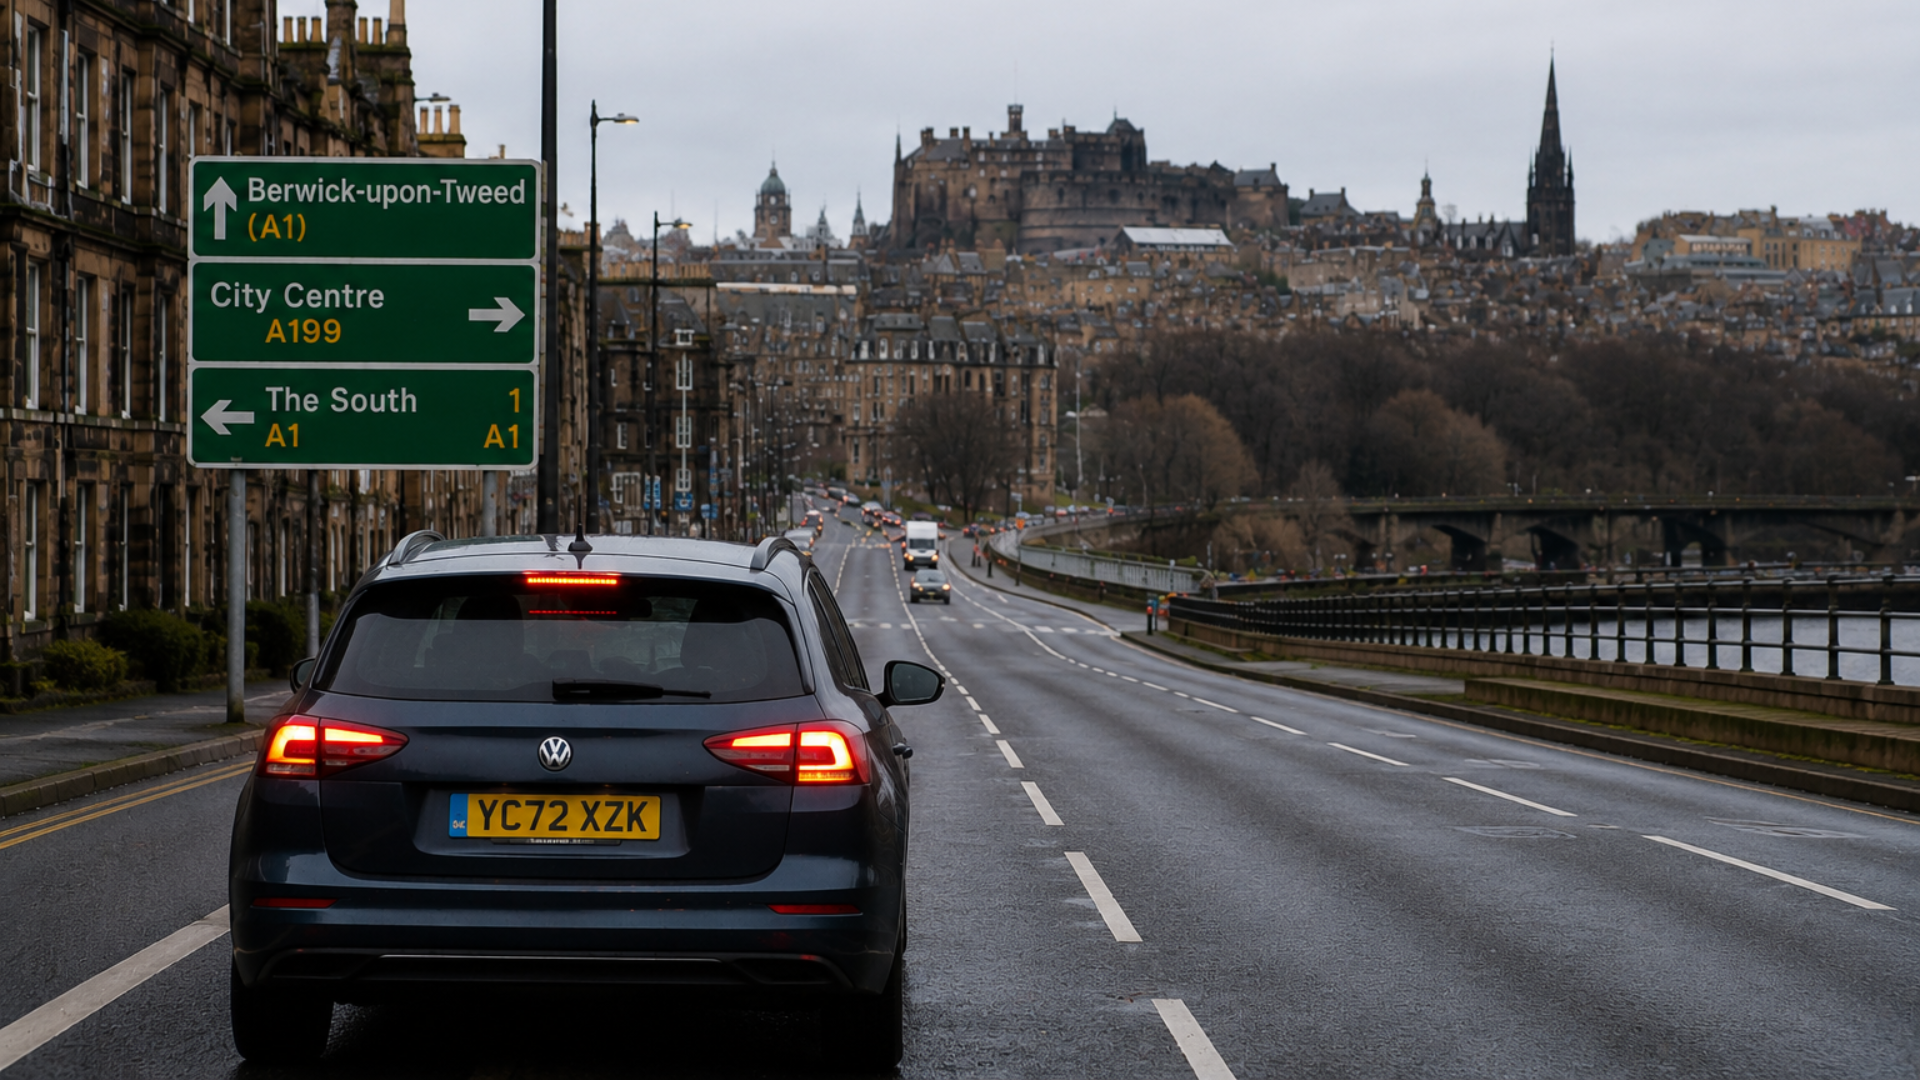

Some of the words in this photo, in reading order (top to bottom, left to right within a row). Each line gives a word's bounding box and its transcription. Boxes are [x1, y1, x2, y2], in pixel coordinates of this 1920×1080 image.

[248, 177, 526, 210] Berwick-upon-Tweed
[248, 213, 306, 242] (A1)
[210, 281, 272, 314] City
[284, 282, 385, 309] Centre
[265, 319, 342, 344] A199
[265, 386, 320, 413] The
[330, 386, 417, 413] South
[508, 387, 521, 413] 1
[264, 423, 299, 448] A1
[483, 424, 519, 449] A1
[538, 736, 572, 770] VW
[477, 799, 569, 831] YC72
[579, 800, 649, 833] XZK
